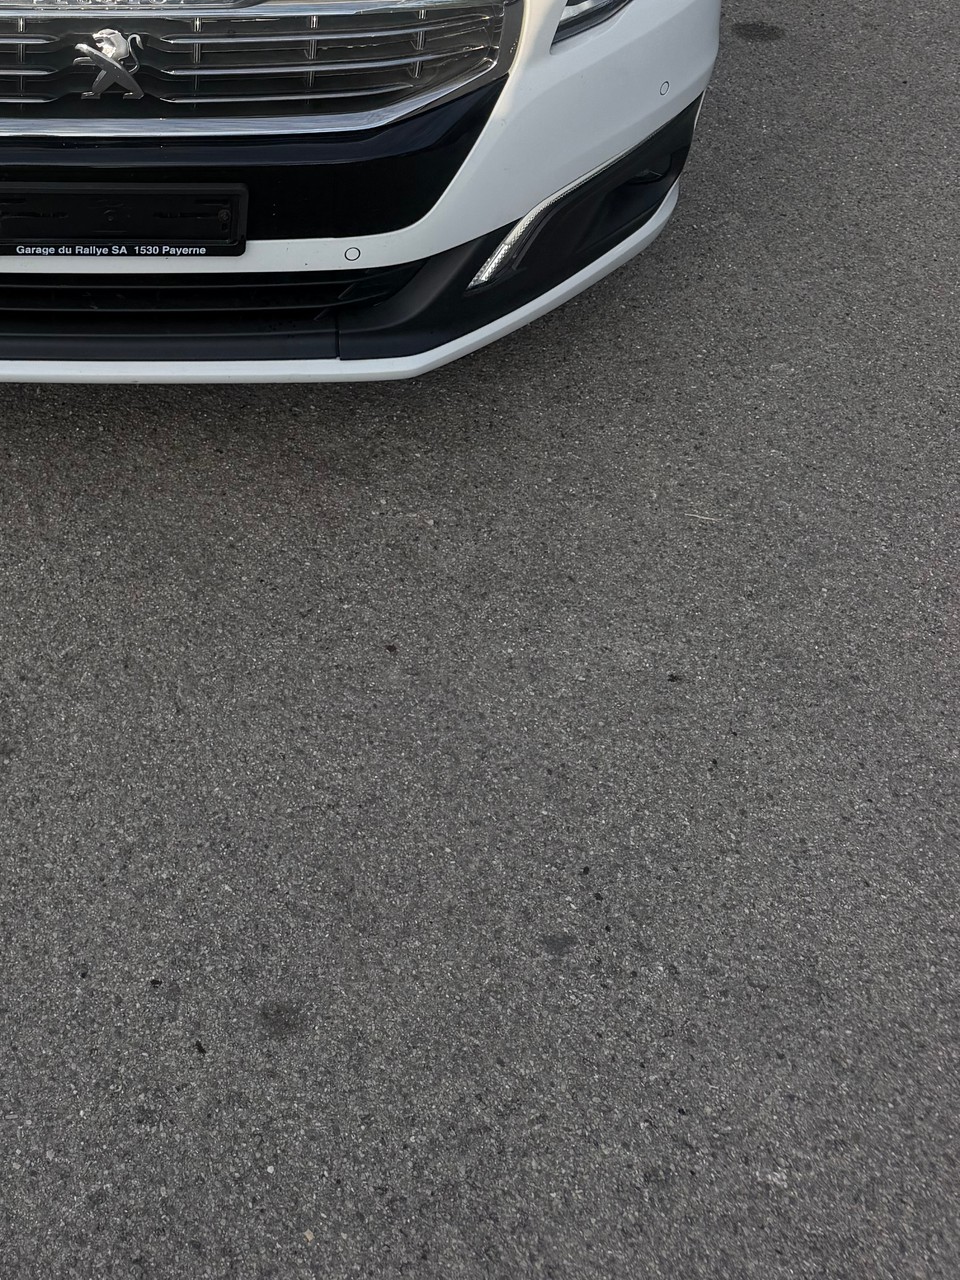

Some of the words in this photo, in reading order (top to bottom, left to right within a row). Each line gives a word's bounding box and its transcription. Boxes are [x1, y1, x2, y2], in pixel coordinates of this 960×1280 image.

[16, 245, 55, 255] Garage
[58, 245, 72, 254] du
[75, 245, 109, 256] Rallye
[111, 245, 128, 254] SA
[134, 245, 160, 254] 1530
[162, 245, 207, 256] Payerne
